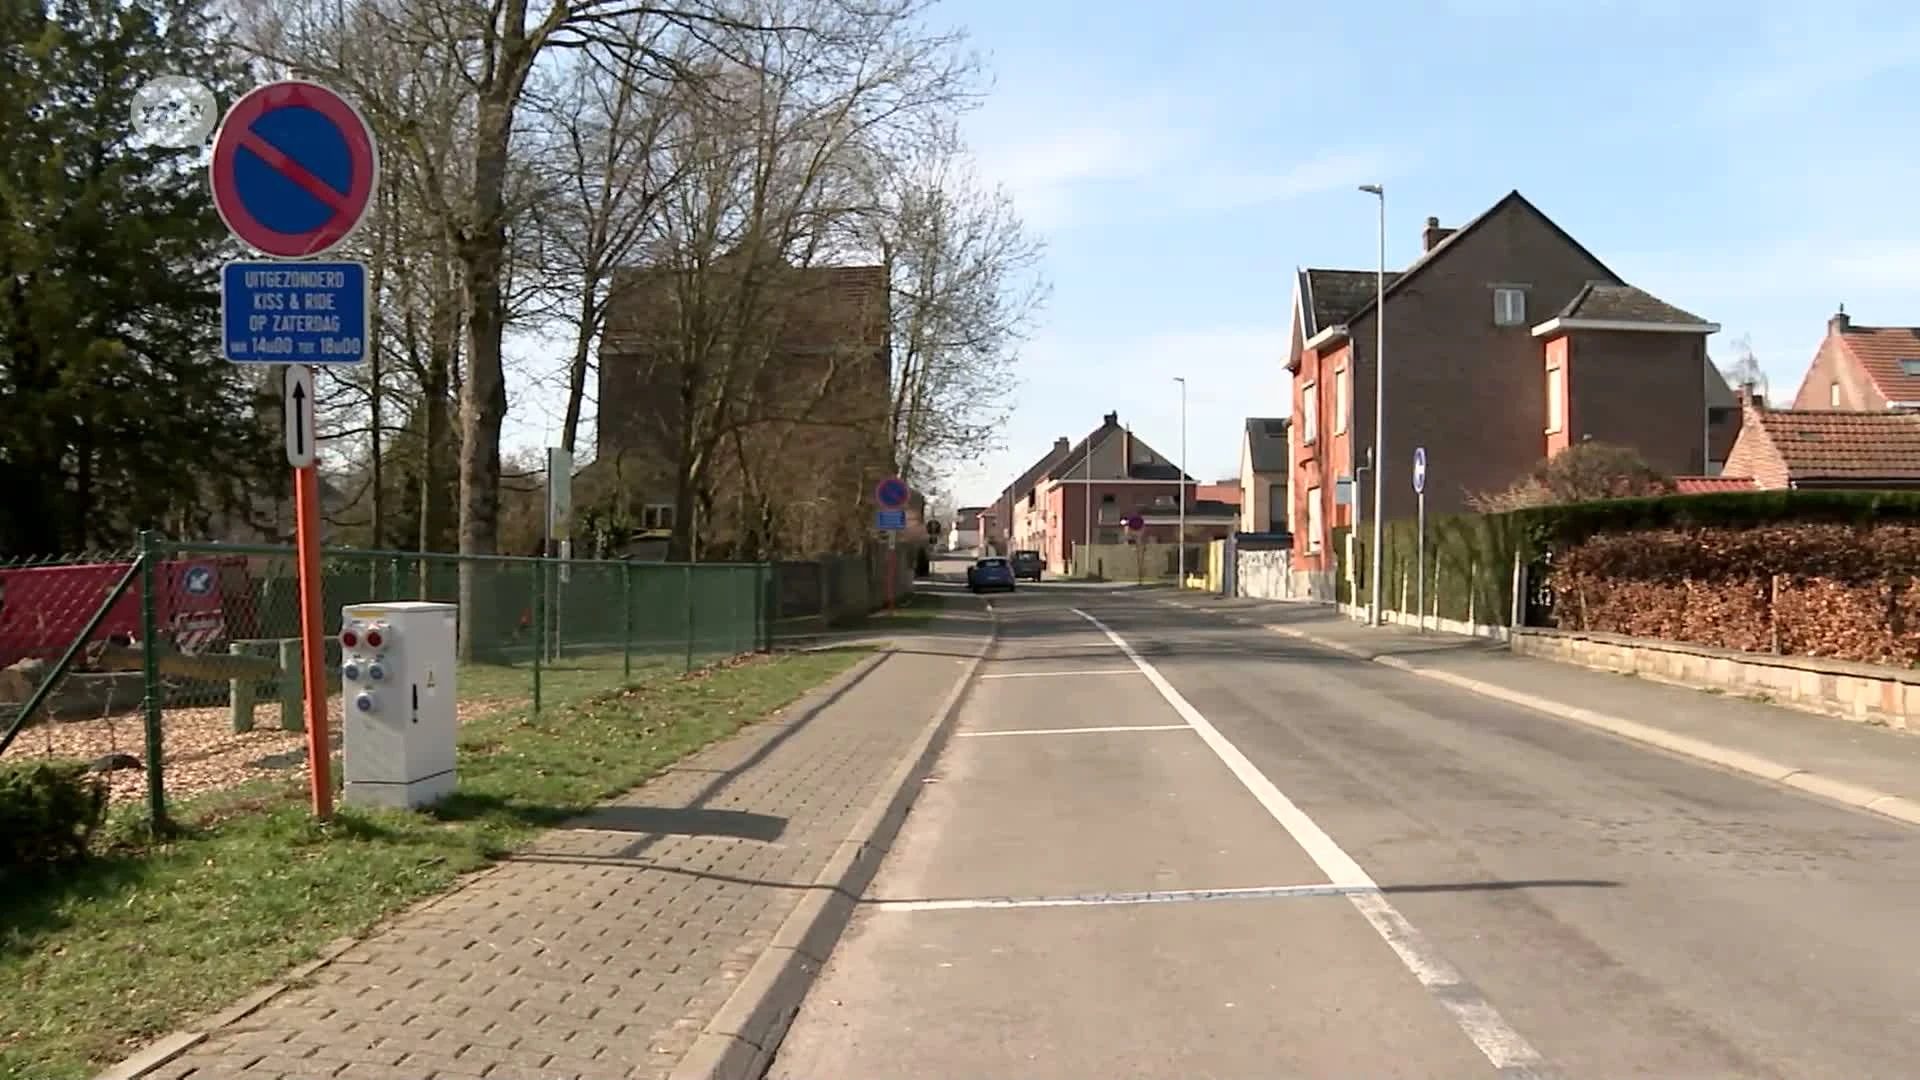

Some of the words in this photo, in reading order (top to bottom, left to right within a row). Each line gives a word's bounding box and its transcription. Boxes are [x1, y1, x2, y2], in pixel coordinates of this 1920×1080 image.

[245, 271, 344, 288] UITGEZONDERD
[253, 293, 284, 310] KISS
[289, 293, 299, 310] &
[305, 293, 336, 310] RIDE
[249, 315, 267, 332] OP
[273, 315, 340, 332] ZATERDAG
